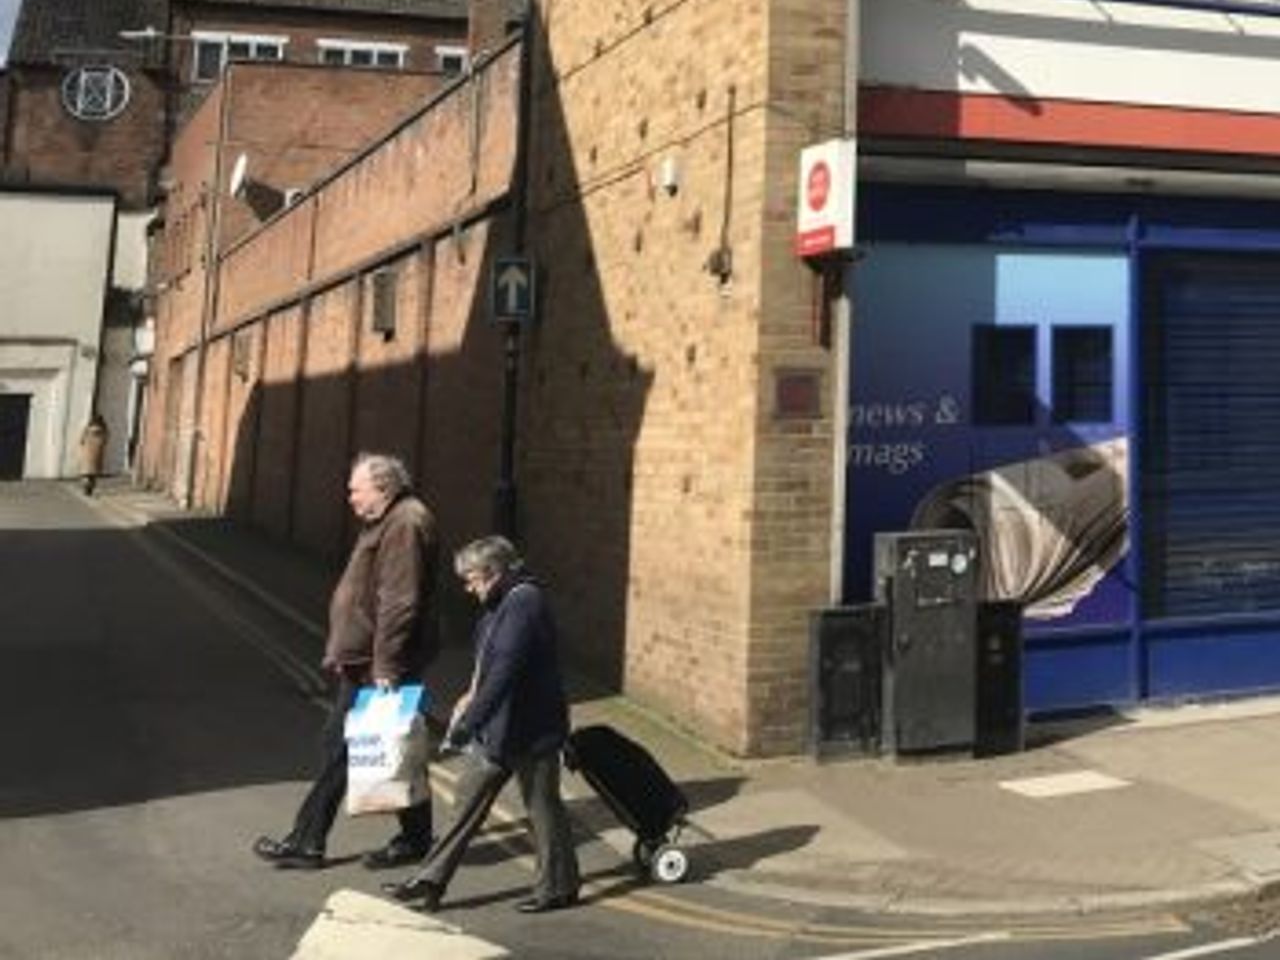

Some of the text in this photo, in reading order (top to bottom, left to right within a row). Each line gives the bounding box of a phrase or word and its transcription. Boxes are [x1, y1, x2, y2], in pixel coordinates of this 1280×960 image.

[850, 394, 961, 428] news &
[849, 441, 926, 475] mags
